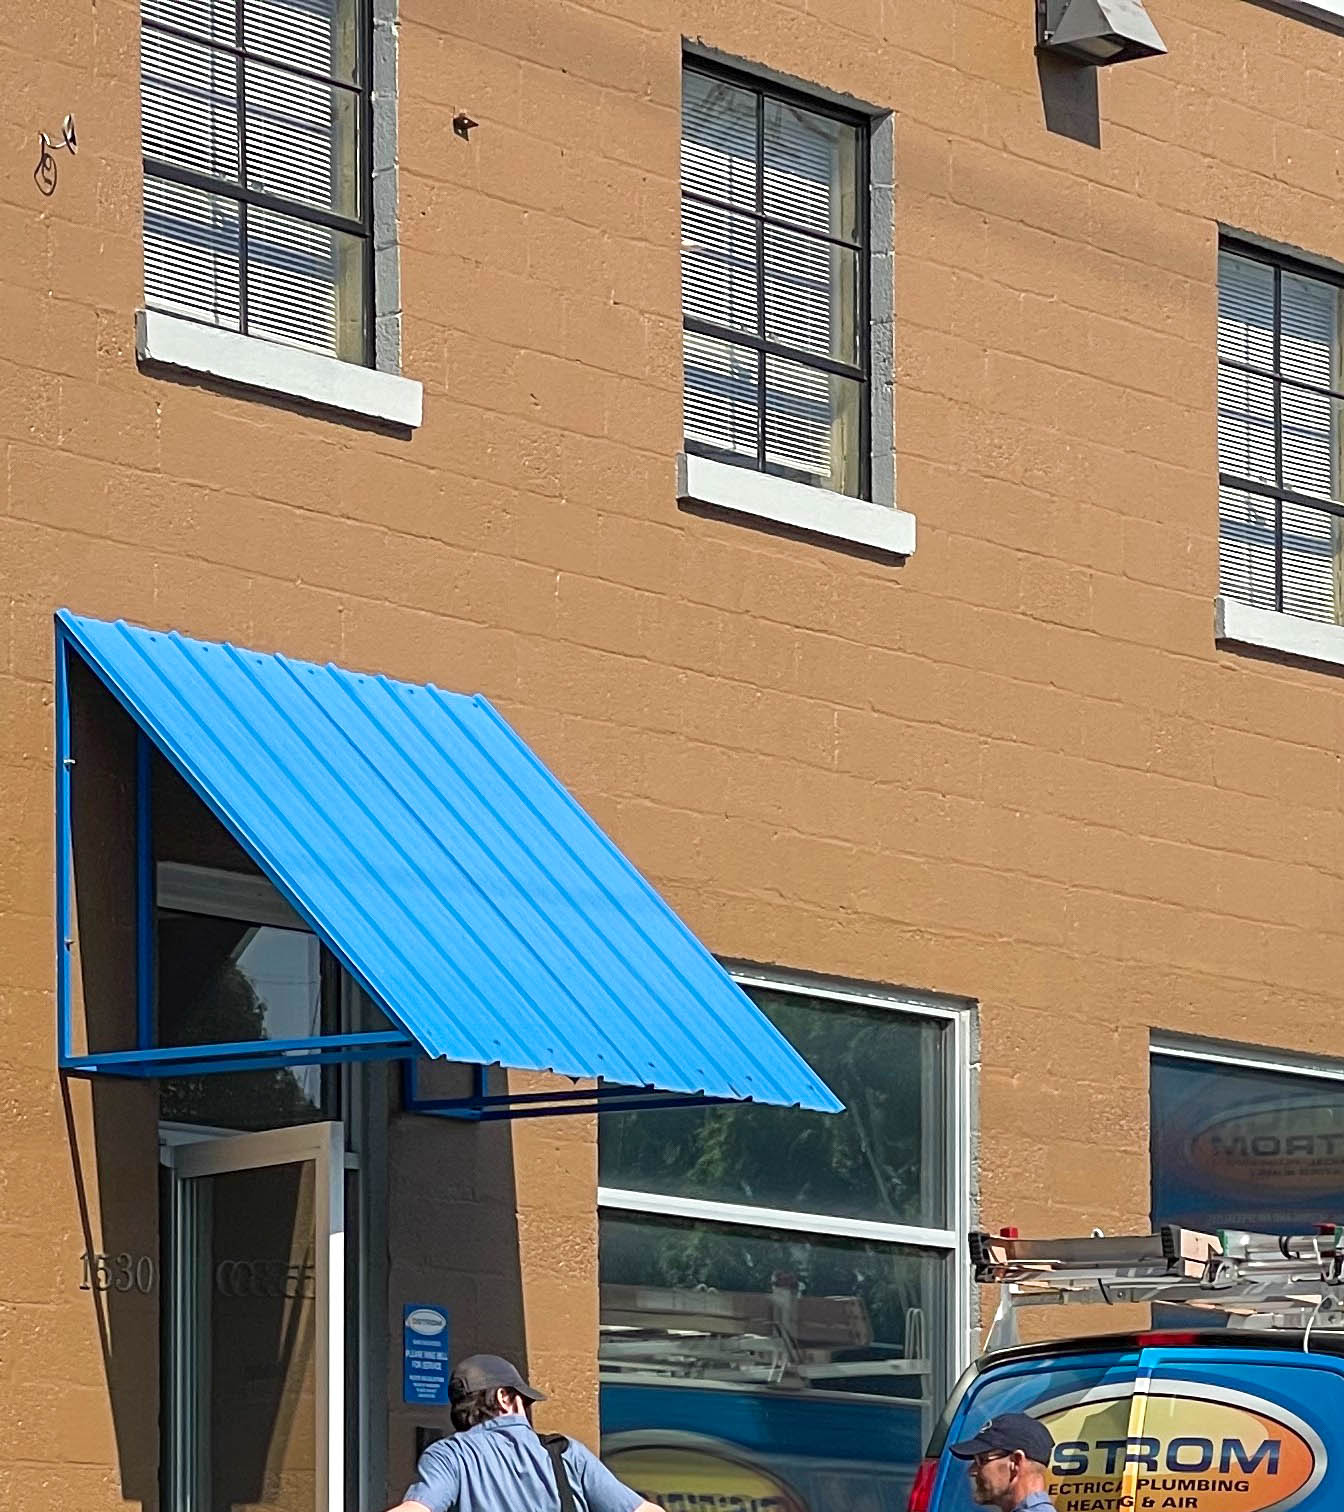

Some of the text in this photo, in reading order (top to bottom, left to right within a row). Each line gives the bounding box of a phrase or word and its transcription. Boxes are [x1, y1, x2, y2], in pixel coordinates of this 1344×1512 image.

[79, 1252, 154, 1294] 1530
[1051, 1436, 1281, 1476] STROM
[1136, 1478, 1250, 1492] PLUMBING
[1142, 1496, 1156, 1508] &
[1162, 1497, 1198, 1508] AIR
